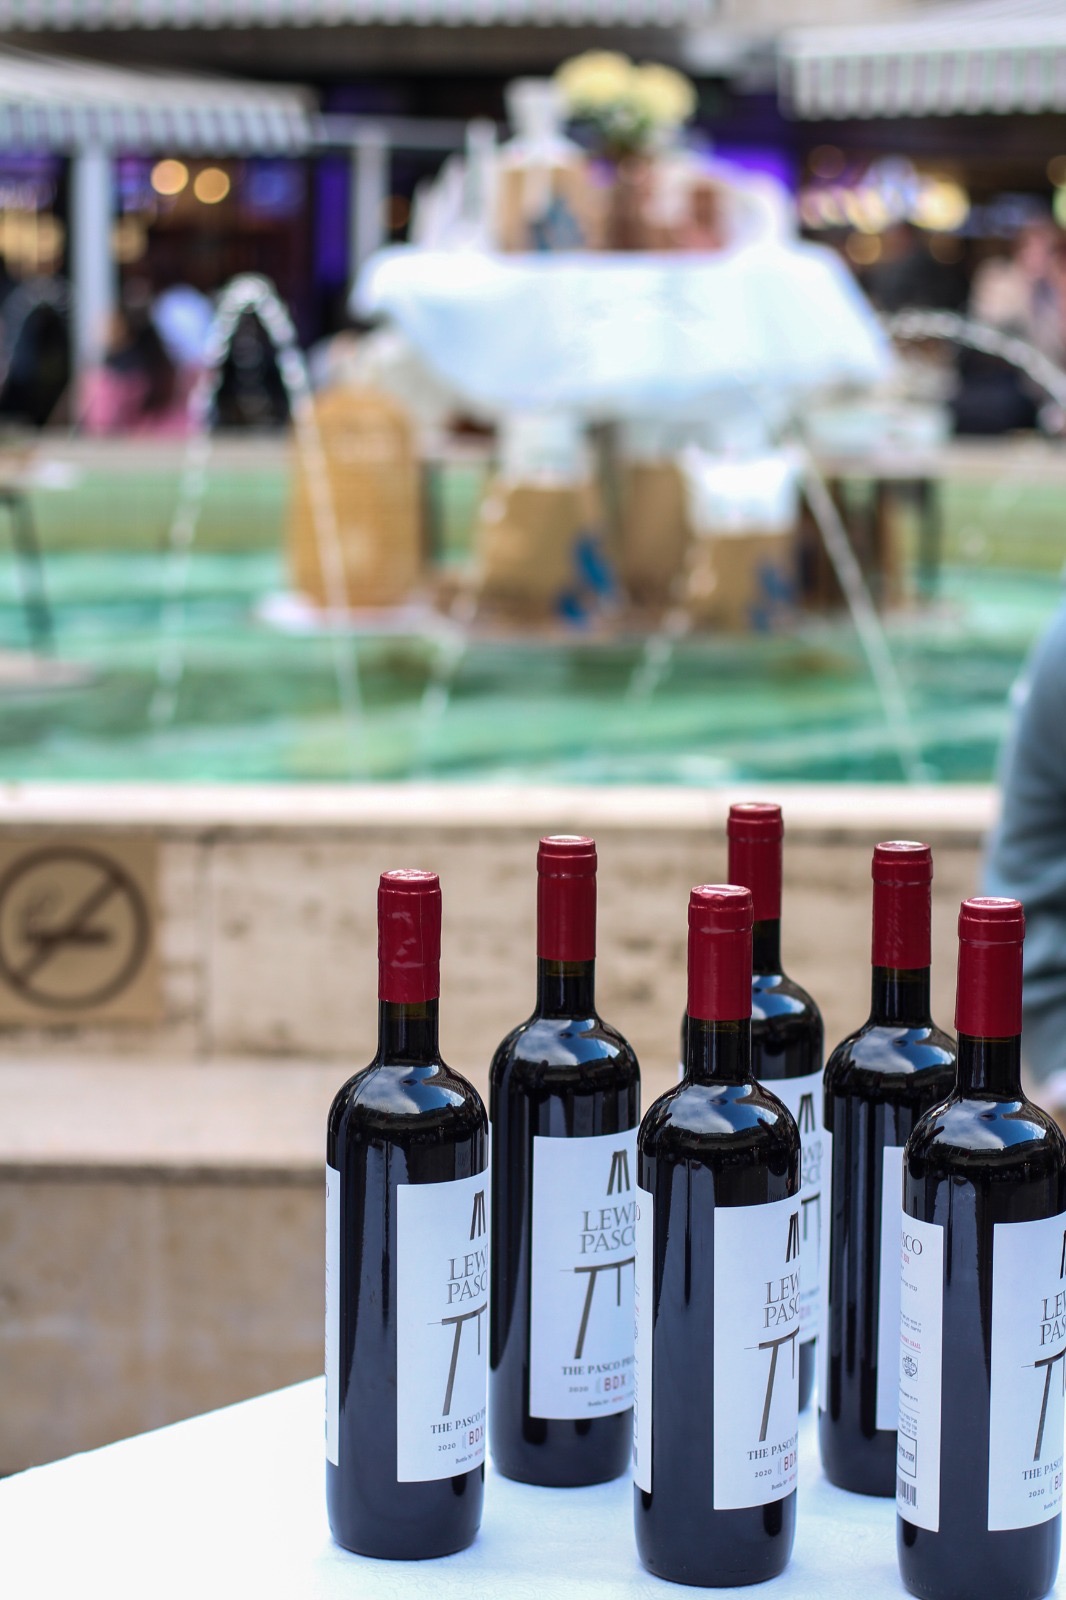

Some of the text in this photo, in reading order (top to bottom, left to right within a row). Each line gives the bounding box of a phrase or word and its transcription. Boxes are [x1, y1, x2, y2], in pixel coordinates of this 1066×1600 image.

[562, 1361, 621, 1376] THE PASCO
[431, 1413, 481, 1434] THE PASCO
[438, 1443, 456, 1451] 2020
[747, 1448, 768, 1460] THE
[755, 1469, 772, 1478] 2020
[1022, 1468, 1042, 1480] THE
[1029, 1489, 1045, 1498] 2020
